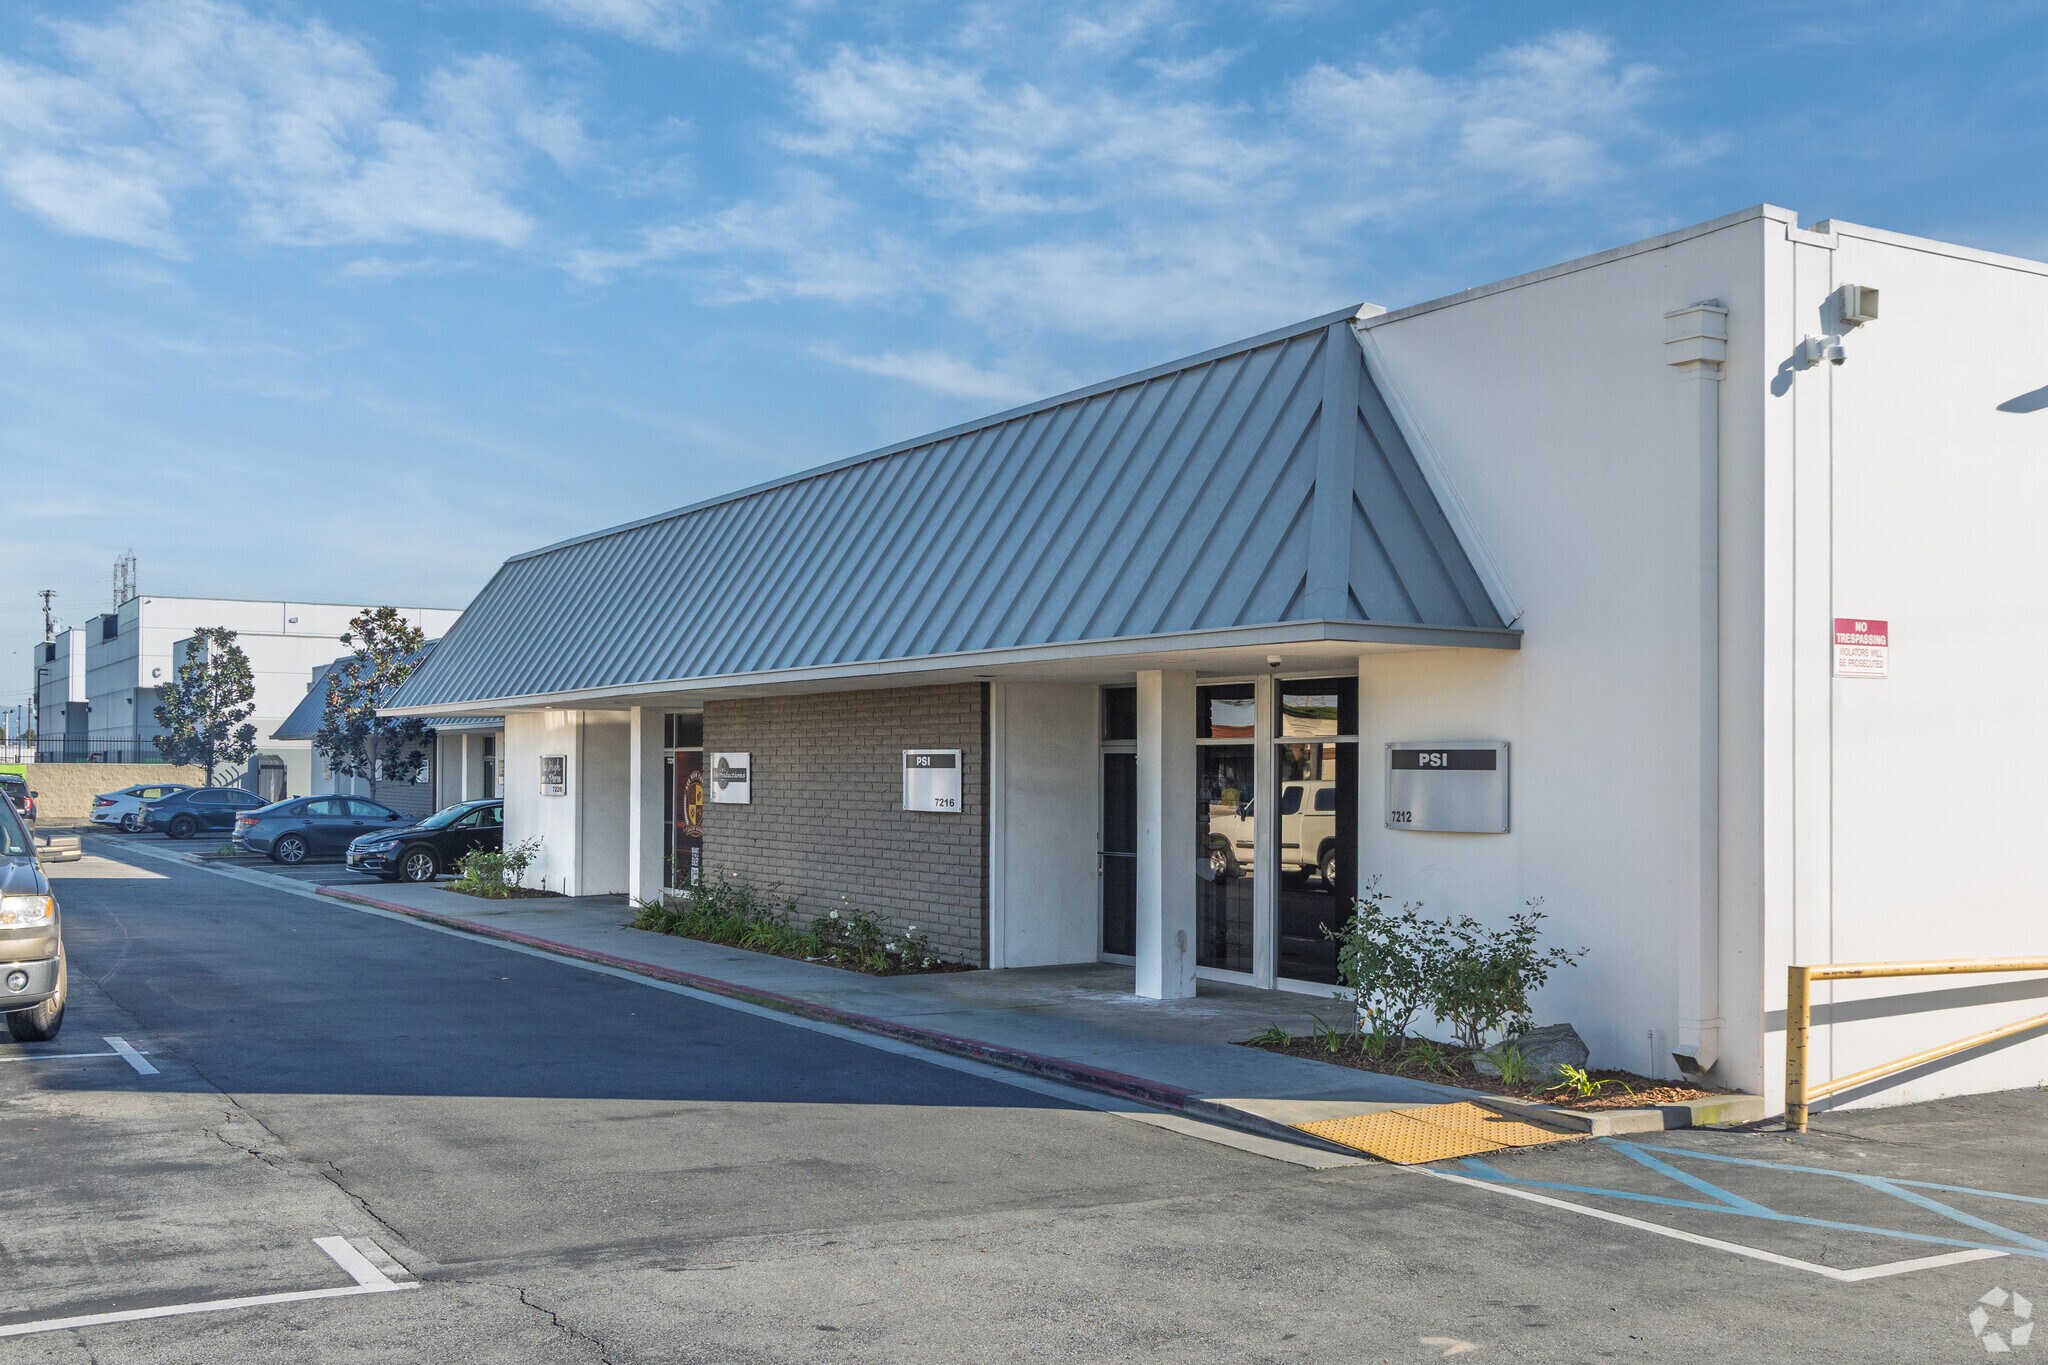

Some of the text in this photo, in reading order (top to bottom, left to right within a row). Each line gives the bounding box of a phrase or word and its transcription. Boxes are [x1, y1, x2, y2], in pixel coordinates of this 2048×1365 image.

[1855, 621, 1867, 632] NO
[1836, 633, 1887, 645] TRESPASSING
[1840, 647, 1869, 657] VIOLATORS
[1839, 658, 1883, 668] BE PROSECUTED
[152, 667, 161, 678] C
[916, 756, 931, 766] PSI
[1419, 753, 1448, 767] PSI
[934, 798, 955, 807] 7216
[1392, 811, 1412, 822] 7212
